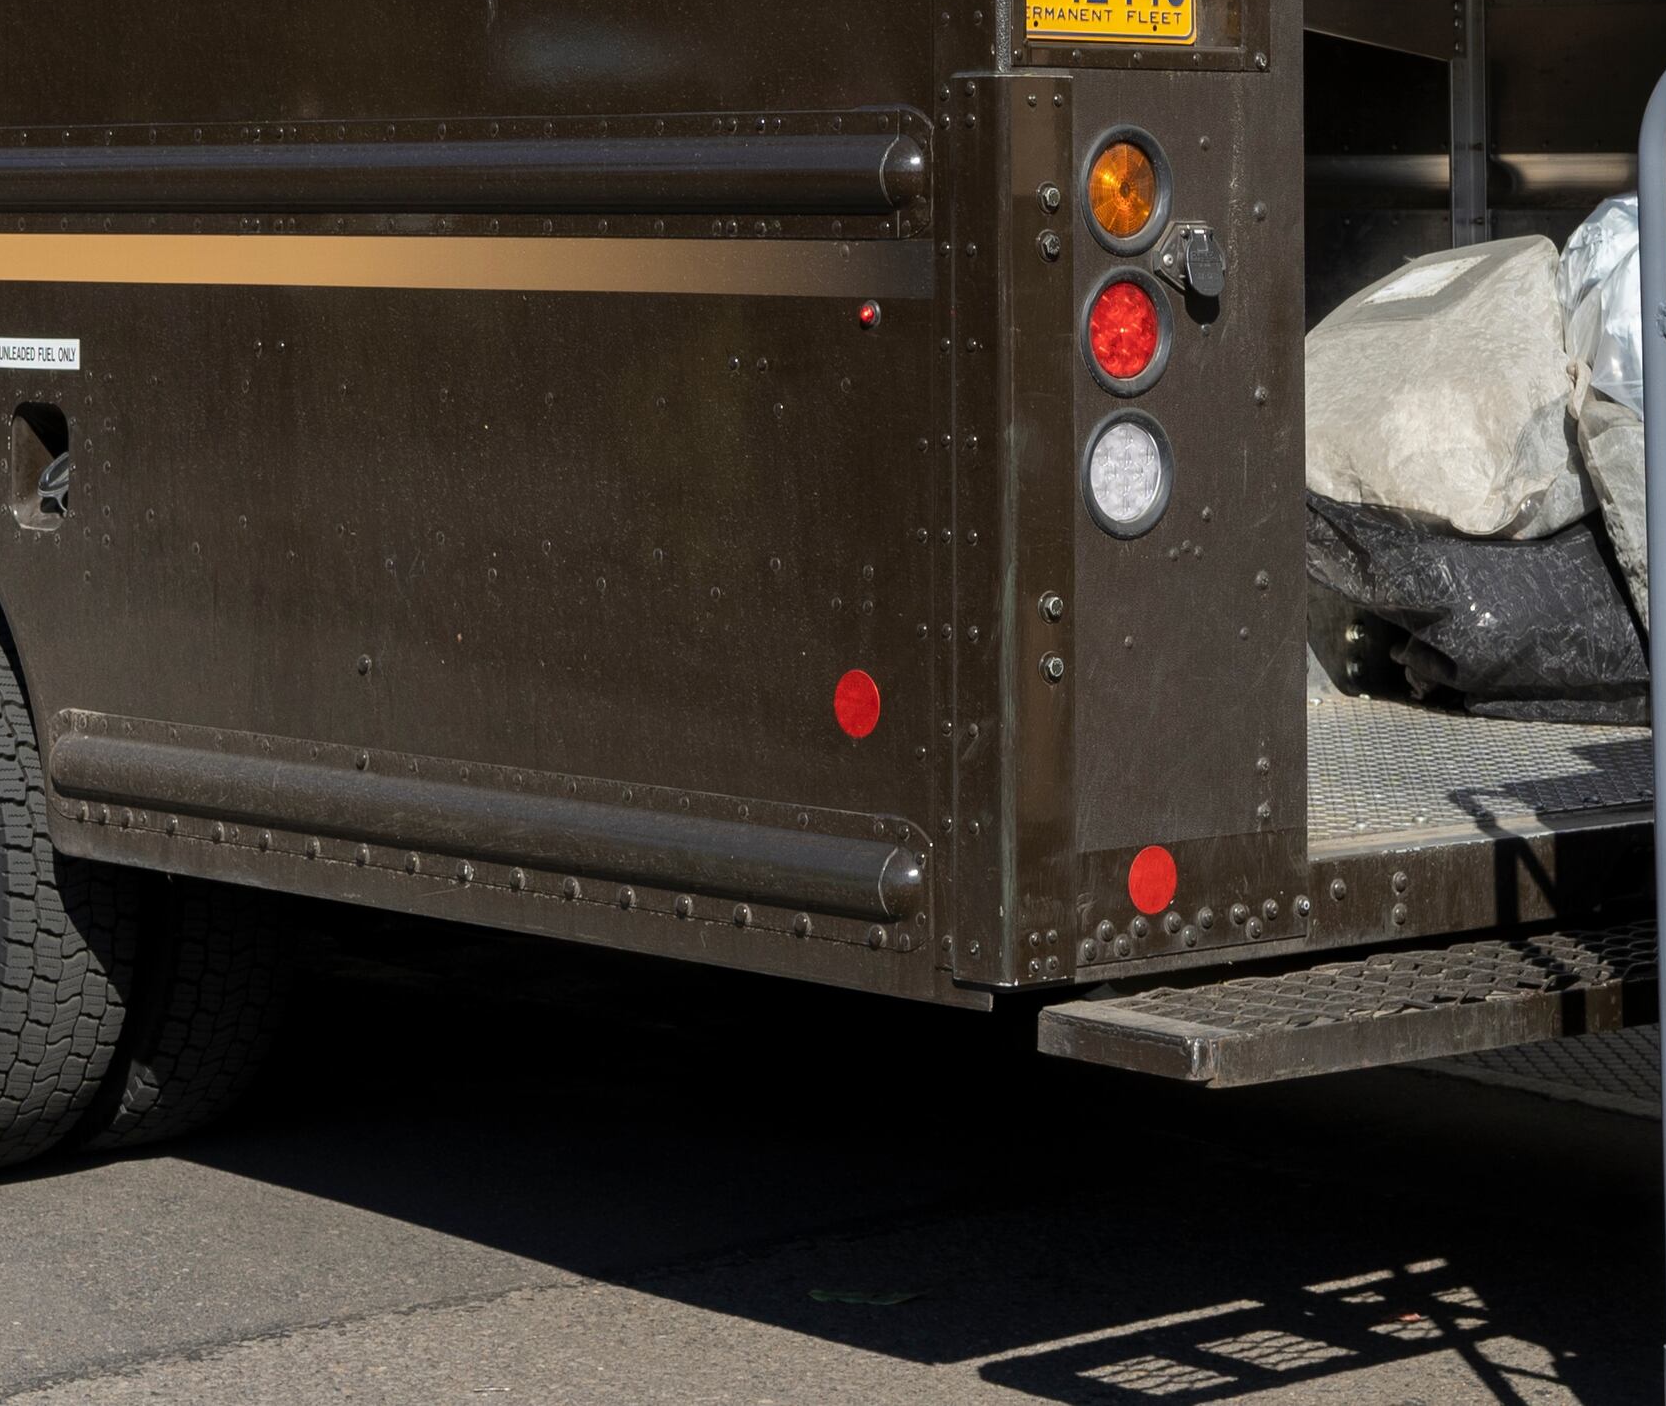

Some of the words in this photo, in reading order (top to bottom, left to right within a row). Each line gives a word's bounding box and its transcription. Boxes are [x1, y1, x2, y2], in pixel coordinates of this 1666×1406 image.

[1026, 5, 1113, 23] ERMANENT
[1126, 10, 1182, 25] FLEET
[37, 347, 56, 362] FUEL
[58, 348, 77, 362] ONLY
